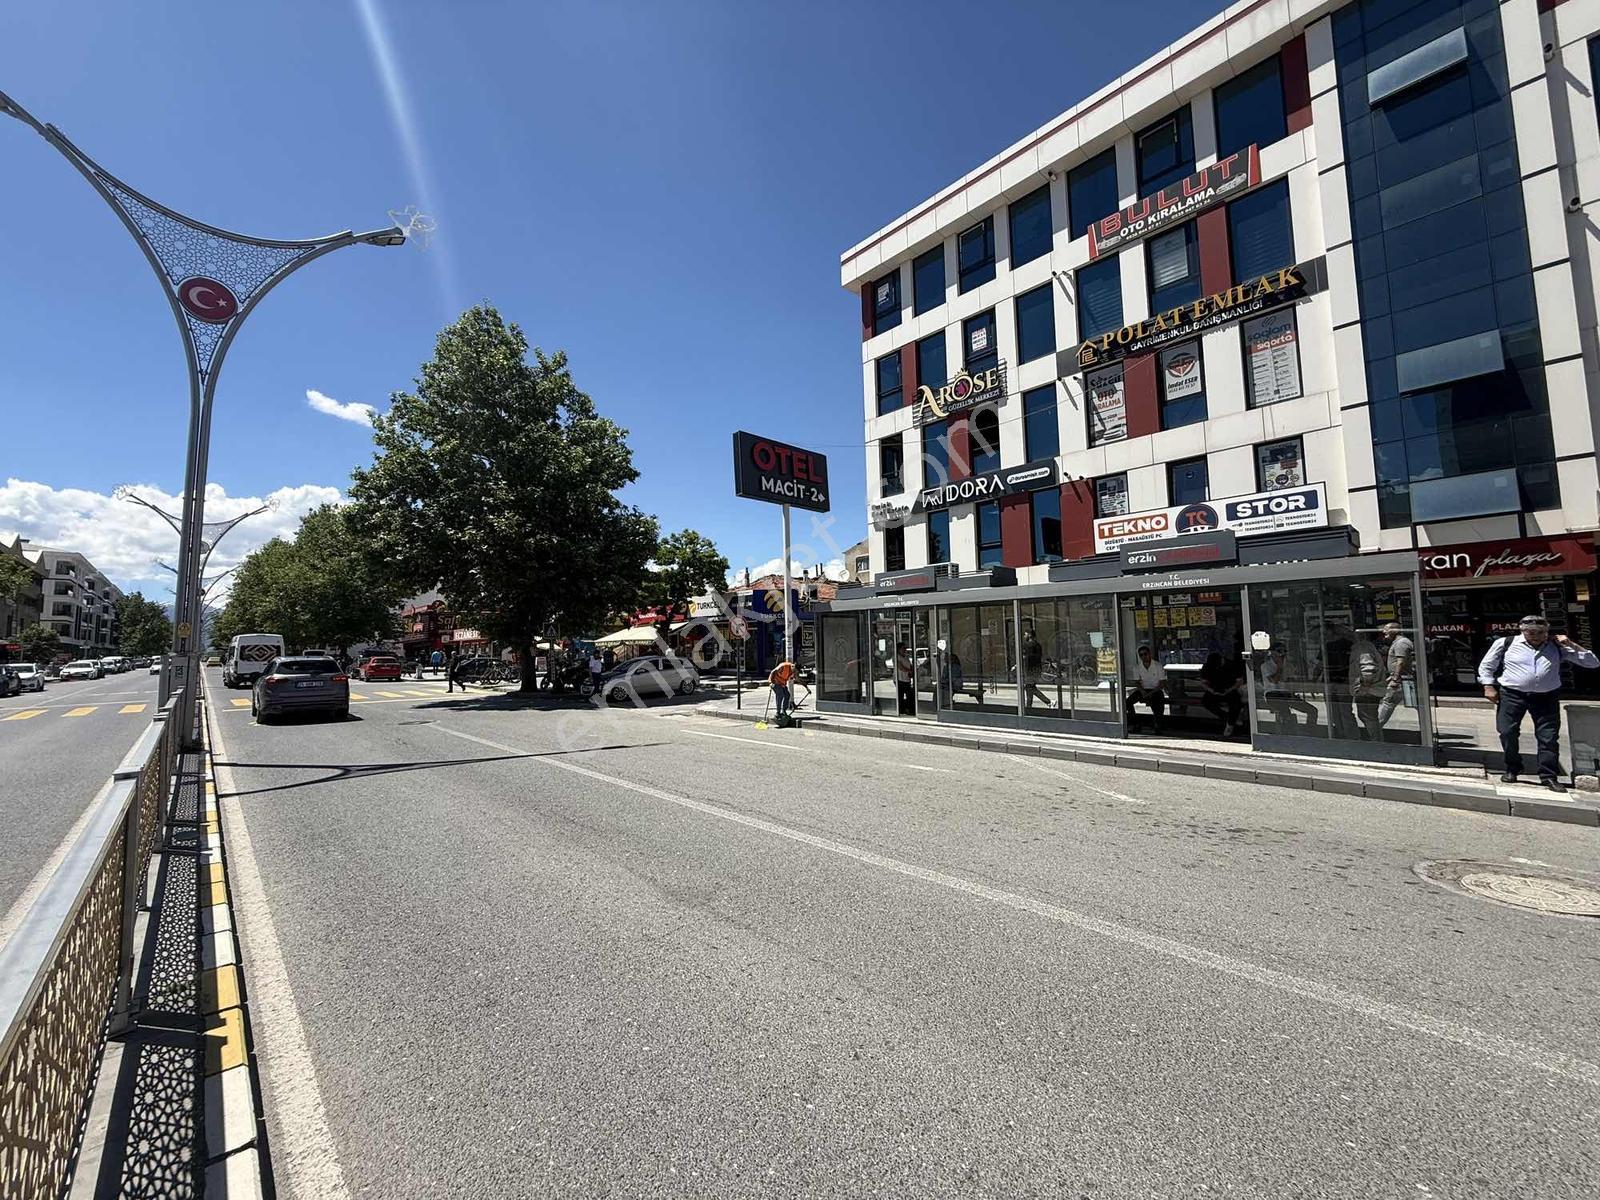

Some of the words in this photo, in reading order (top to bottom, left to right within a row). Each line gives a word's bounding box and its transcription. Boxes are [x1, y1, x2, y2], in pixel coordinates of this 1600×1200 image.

[1101, 154, 1238, 237] BULUT
[1120, 221, 1144, 237] OTO
[1102, 309, 1184, 350] POLAT
[1192, 265, 1300, 319] EMLAK
[753, 441, 824, 484] OTEL
[761, 475, 818, 502] MACİT-2
[945, 474, 1005, 502] DORA
[1236, 495, 1306, 518] STOR
[1099, 516, 1166, 537] TEKNO
[1473, 549, 1562, 578] plaza
[1431, 624, 1464, 632] ALKAN
[1491, 623, 1521, 631] PLAZ
